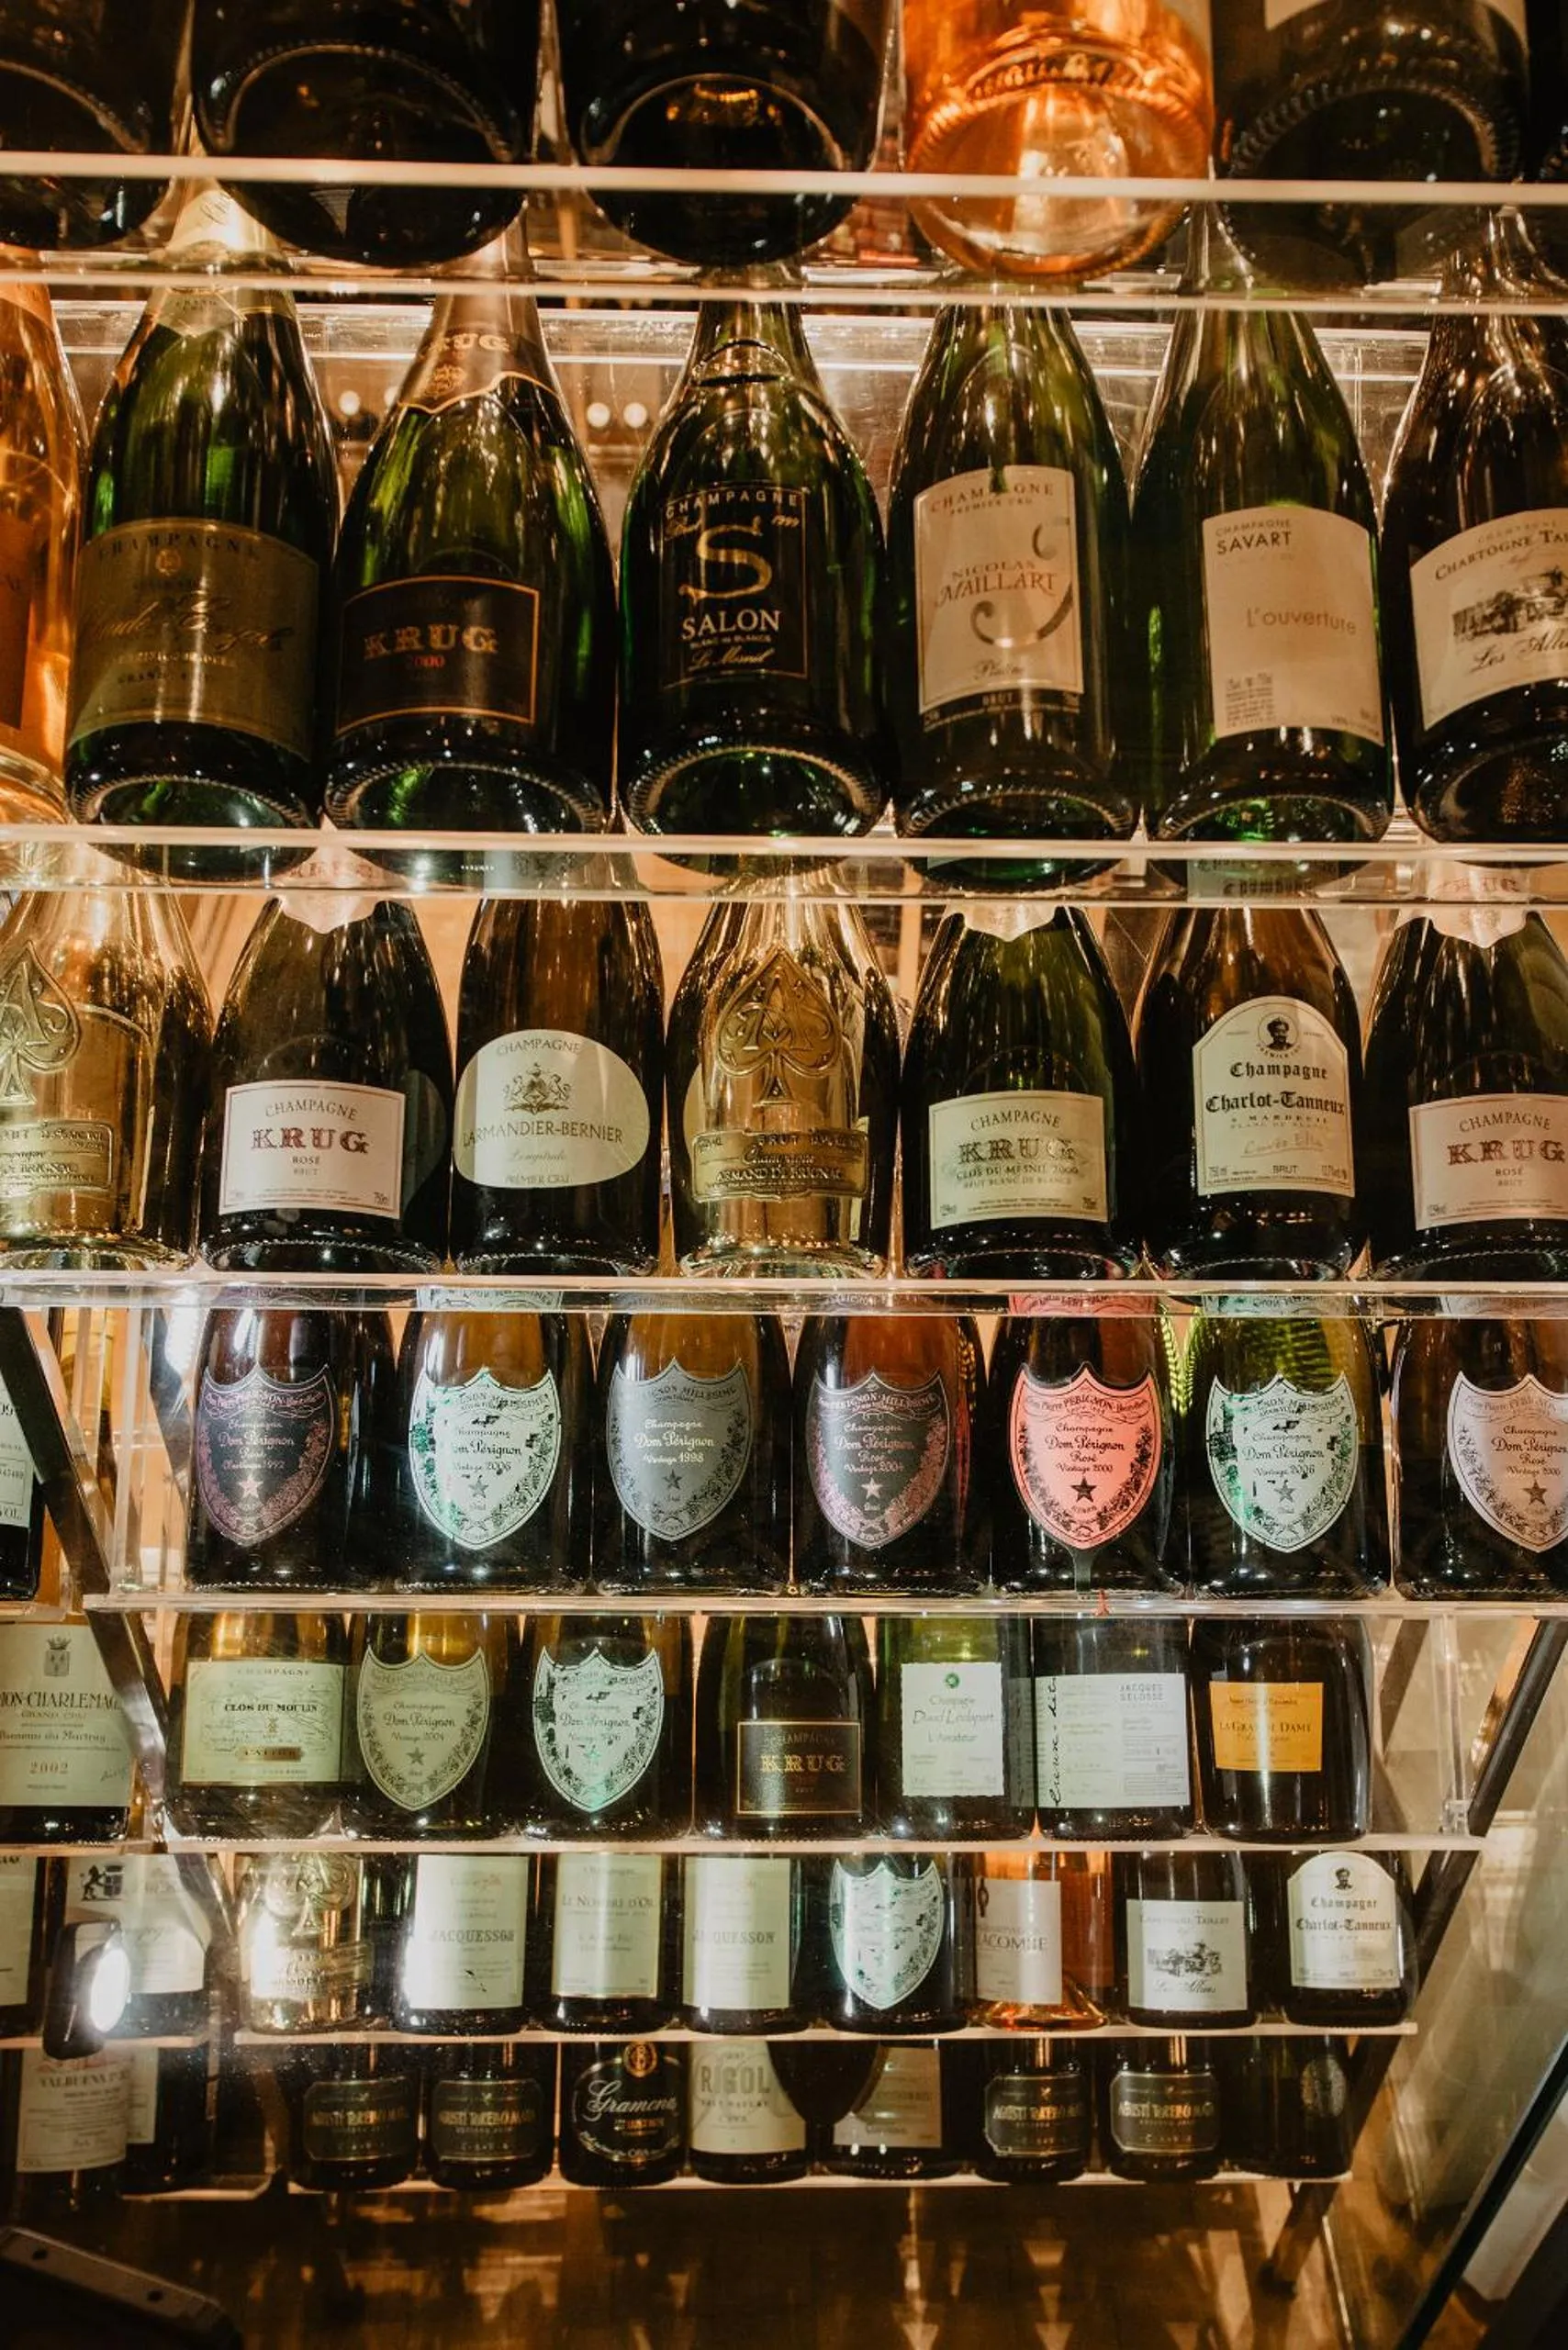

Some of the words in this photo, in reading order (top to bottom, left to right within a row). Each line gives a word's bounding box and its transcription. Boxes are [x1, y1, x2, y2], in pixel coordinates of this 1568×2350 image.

[666, 489, 799, 520] CHAMPAGNE
[930, 482, 1055, 514] CHAMGNE
[1215, 519, 1292, 537] CHAMPAGNE
[1216, 531, 1293, 556] SAVART
[952, 560, 1036, 578] NICOLAS
[679, 609, 781, 641] SALON
[1247, 607, 1357, 635] L'ouverture
[364, 623, 498, 660] KRUG
[496, 1038, 581, 1056] CHAMPAGNE
[1229, 1061, 1328, 1080] Champagne
[265, 1098, 359, 1122] CHAMPAGNE
[1204, 1090, 1346, 1116] Charlot-Tanneux
[970, 1109, 1062, 1131] CHAMPAGNE
[1459, 1111, 1552, 1133] CHAMPAGNE
[251, 1127, 370, 1154] KRUG
[463, 1120, 623, 1148] LARMANDIER-BERNIER
[958, 1137, 1078, 1165] KRUG
[1447, 1140, 1565, 1166] KRUG
[957, 1169, 982, 1181] CLOS
[1272, 1165, 1299, 1175] BRUT
[458, 1429, 510, 1439] hampagne
[644, 1418, 705, 1431] Champagne
[844, 1422, 903, 1433] Champagne
[1056, 1423, 1114, 1436] Champagne
[1503, 1425, 1559, 1438] Champagne
[633, 1432, 663, 1449] Dom
[663, 1430, 715, 1451] Pérignon
[836, 1435, 862, 1450] Dom
[862, 1433, 916, 1454] Pérignon
[1044, 1435, 1073, 1451] Dom
[1074, 1434, 1125, 1454] Pérignon
[1490, 1436, 1524, 1453] Dom
[1242, 1447, 1271, 1460] Dom
[224, 1703, 255, 1713] CLOS
[257, 1703, 274, 1713] DU
[276, 1703, 319, 1713] MOULIN
[382, 1712, 409, 1727] Dom
[1280, 1721, 1313, 1734] DAME
[760, 1754, 847, 1774] KRUG
[1310, 1897, 1378, 1910] Champagne
[1295, 1917, 1392, 1931] Charlot-Tanneux
[700, 2065, 770, 2094] RIGOL
